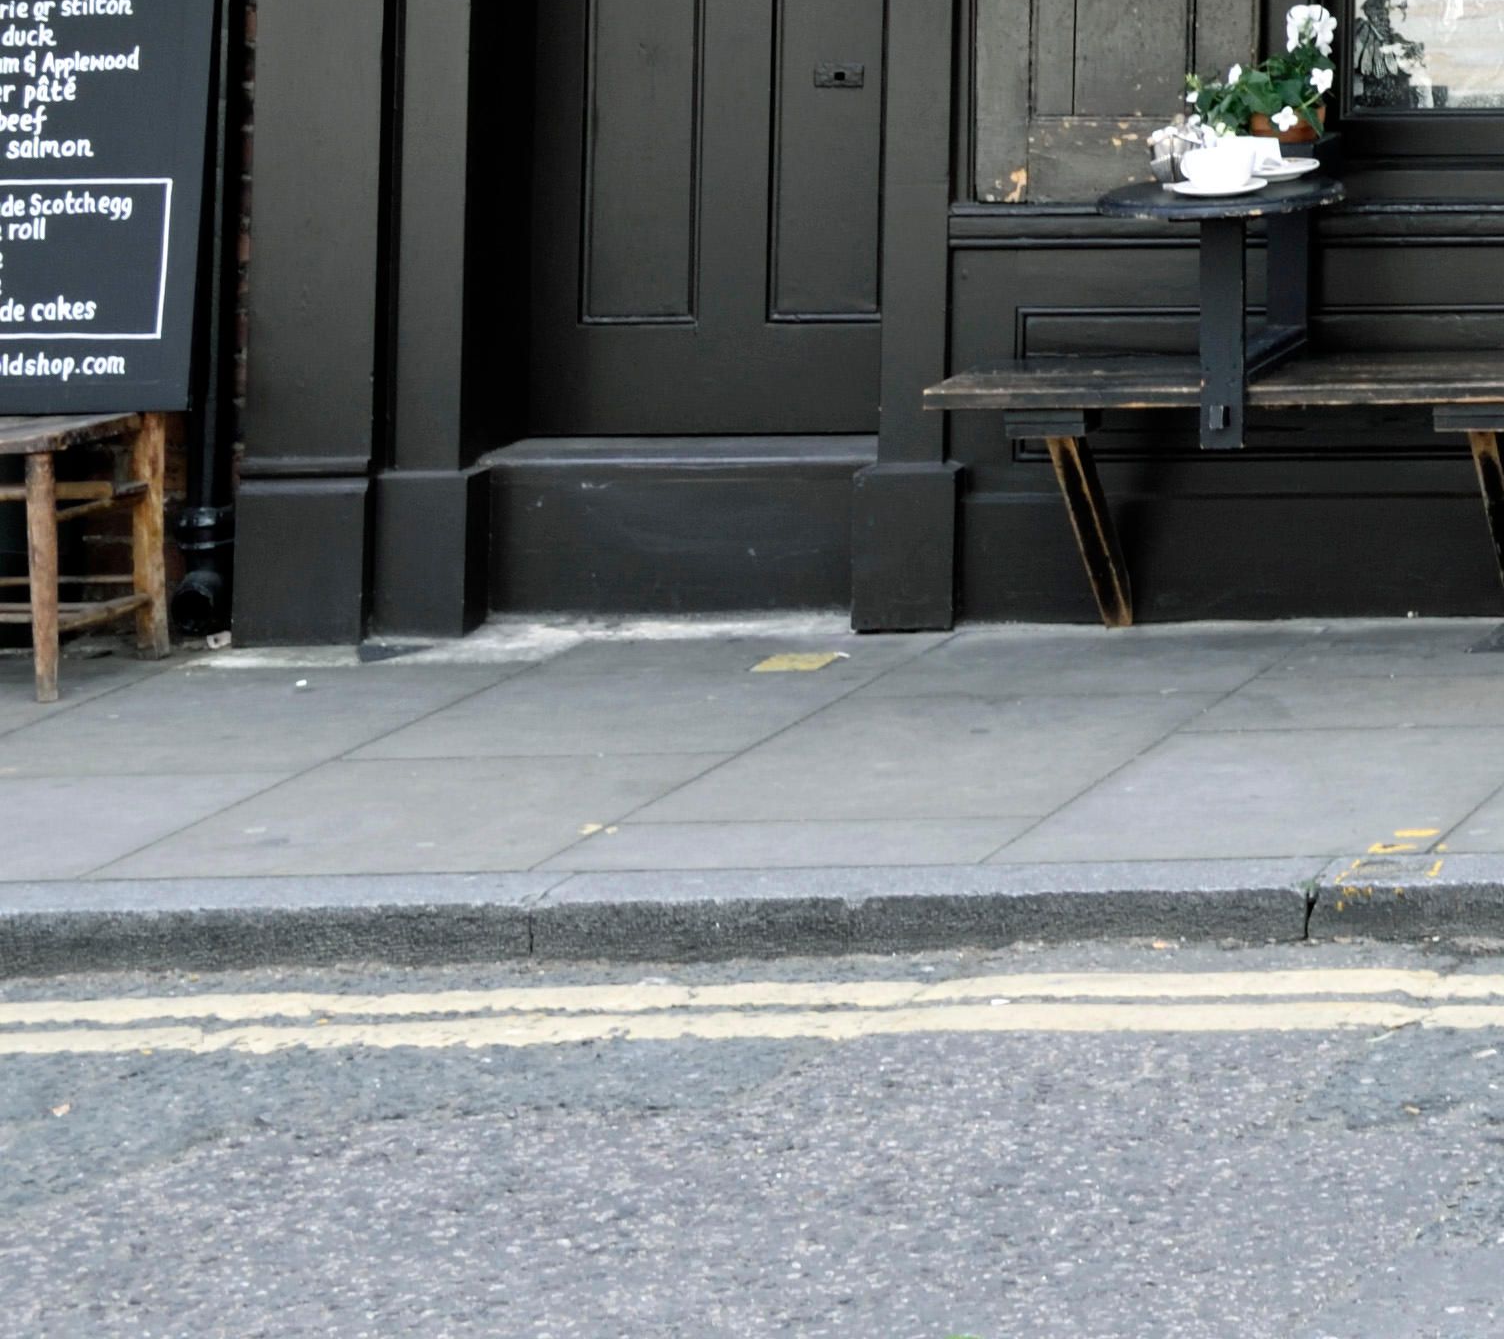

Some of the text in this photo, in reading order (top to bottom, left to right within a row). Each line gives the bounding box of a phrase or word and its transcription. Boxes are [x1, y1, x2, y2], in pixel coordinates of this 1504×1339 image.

[33, 0, 56, 22] or
[2, 23, 57, 47] duck
[23, 50, 37, 78] &
[42, 45, 140, 80] Applewood
[23, 74, 77, 109] pâté
[6, 134, 95, 160] salmon
[29, 190, 96, 216] Scotch
[97, 195, 133, 221] egg
[8, 216, 47, 241] roll
[31, 295, 98, 322] cakes
